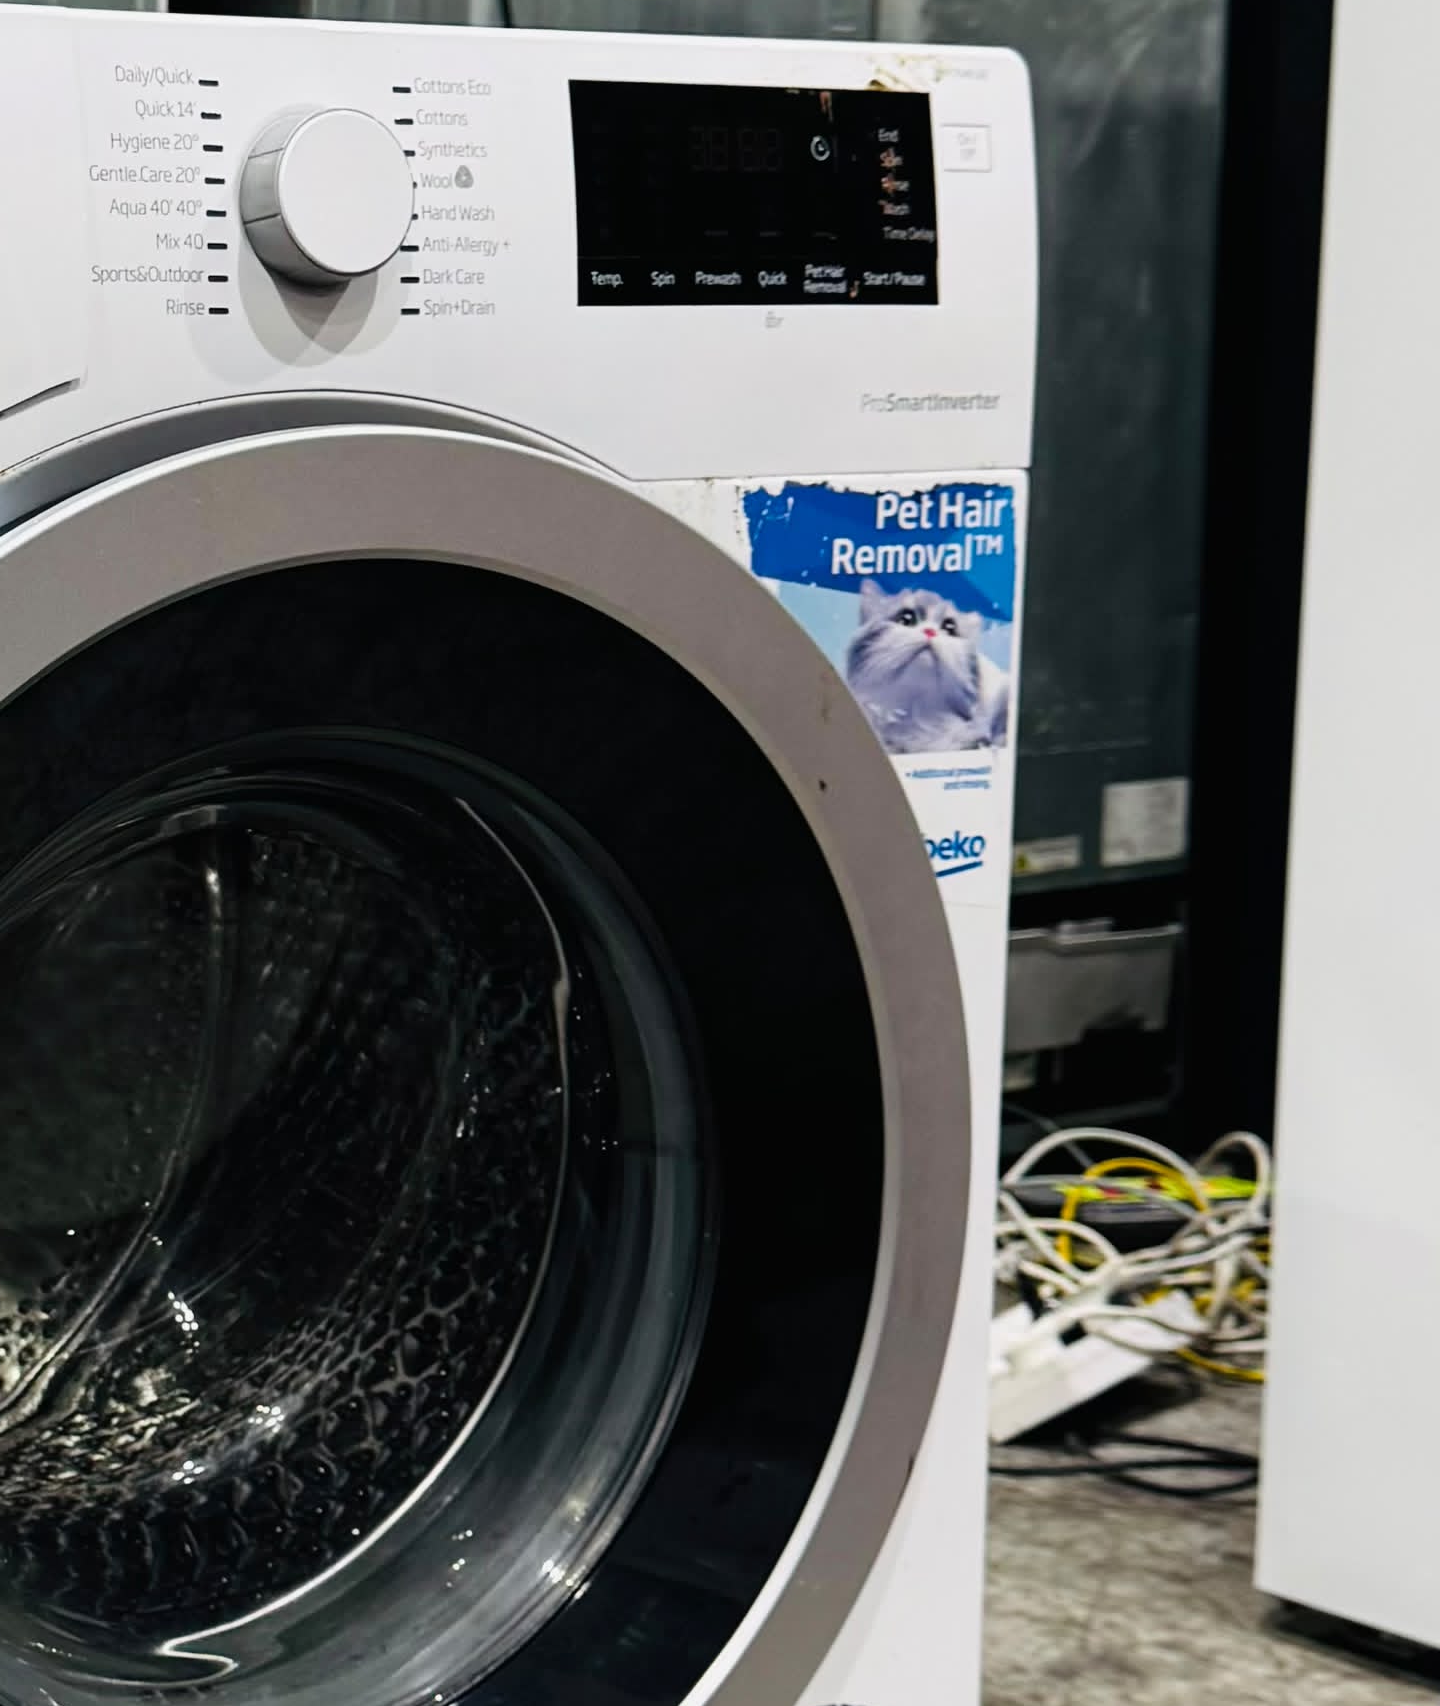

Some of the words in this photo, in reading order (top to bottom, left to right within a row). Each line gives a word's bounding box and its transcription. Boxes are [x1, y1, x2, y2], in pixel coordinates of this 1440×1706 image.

[115, 65, 194, 87] Daily/Quick
[414, 77, 466, 94] Cottons
[135, 99, 174, 120] Quick
[416, 108, 468, 126] Cottons
[110, 133, 170, 153] Hygiene
[418, 141, 488, 160] Synthetics
[419, 173, 453, 189] Wool
[109, 198, 147, 219] Aqua
[421, 205, 456, 221] Hand
[459, 205, 496, 221] Wash
[155, 233, 181, 250] Mix
[183, 233, 204, 250] 40
[422, 237, 499, 257] Anti-Allergy
[91, 265, 205, 285] Sports&Outdoor
[423, 269, 453, 284] Dark
[455, 269, 485, 285] Care
[590, 270, 624, 288] Temp.
[650, 270, 676, 287] Spin
[694, 270, 742, 286] Prewash
[757, 270, 788, 288] Quick
[165, 299, 206, 316] Rinse
[875, 493, 934, 530] Pet
[938, 490, 1008, 529] Hair
